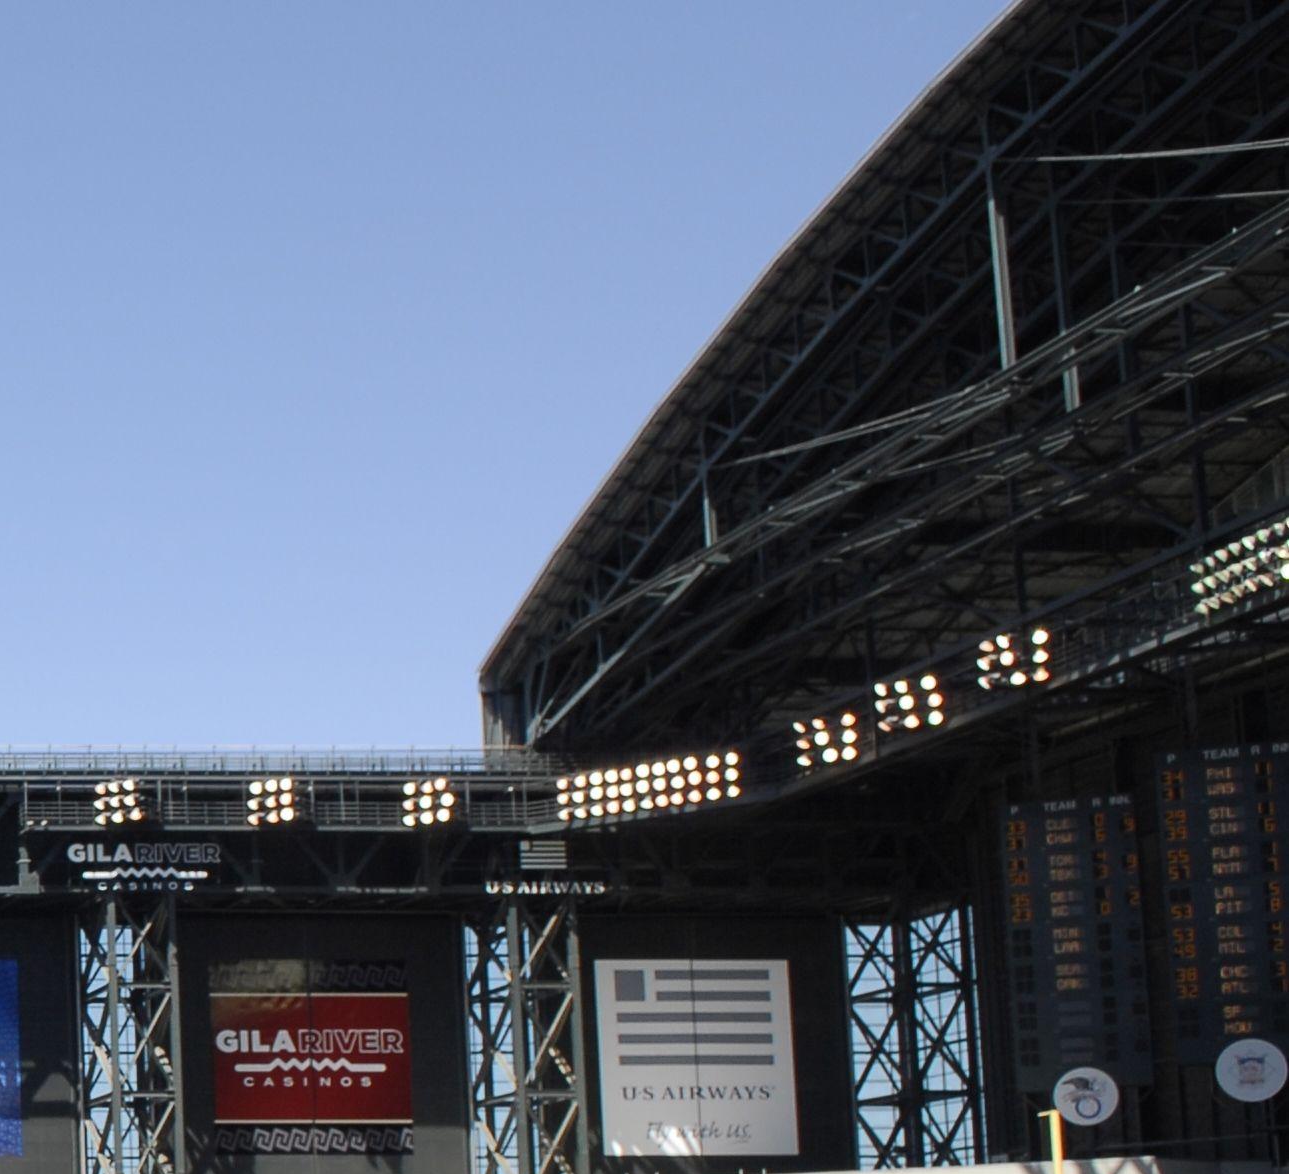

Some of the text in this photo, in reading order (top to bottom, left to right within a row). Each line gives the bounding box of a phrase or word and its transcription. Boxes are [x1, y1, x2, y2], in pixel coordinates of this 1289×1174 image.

[1166, 748, 1240, 764] P TEAM
[1206, 767, 1234, 780] PHI
[1010, 800, 1077, 815] P TEAM
[1209, 806, 1235, 820] STL
[1210, 822, 1239, 835] CIN
[1166, 846, 1241, 865] 55 FLA
[1167, 865, 1192, 880] 57
[97, 881, 195, 892] CASINOS
[517, 880, 606, 894] AIRWAYS
[1215, 886, 1234, 899] LA
[1169, 902, 1244, 919] 53 PIT
[1173, 927, 1196, 943] 53
[1217, 926, 1244, 939] COL
[1174, 943, 1197, 959] 49
[1218, 941, 1246, 954] MIL
[1220, 965, 1248, 978] CHC
[1177, 981, 1248, 999] 32 ATL
[1225, 1021, 1253, 1034] HOU
[243, 1076, 373, 1088] CASINOS
[662, 1085, 773, 1101] AIRWAYS
